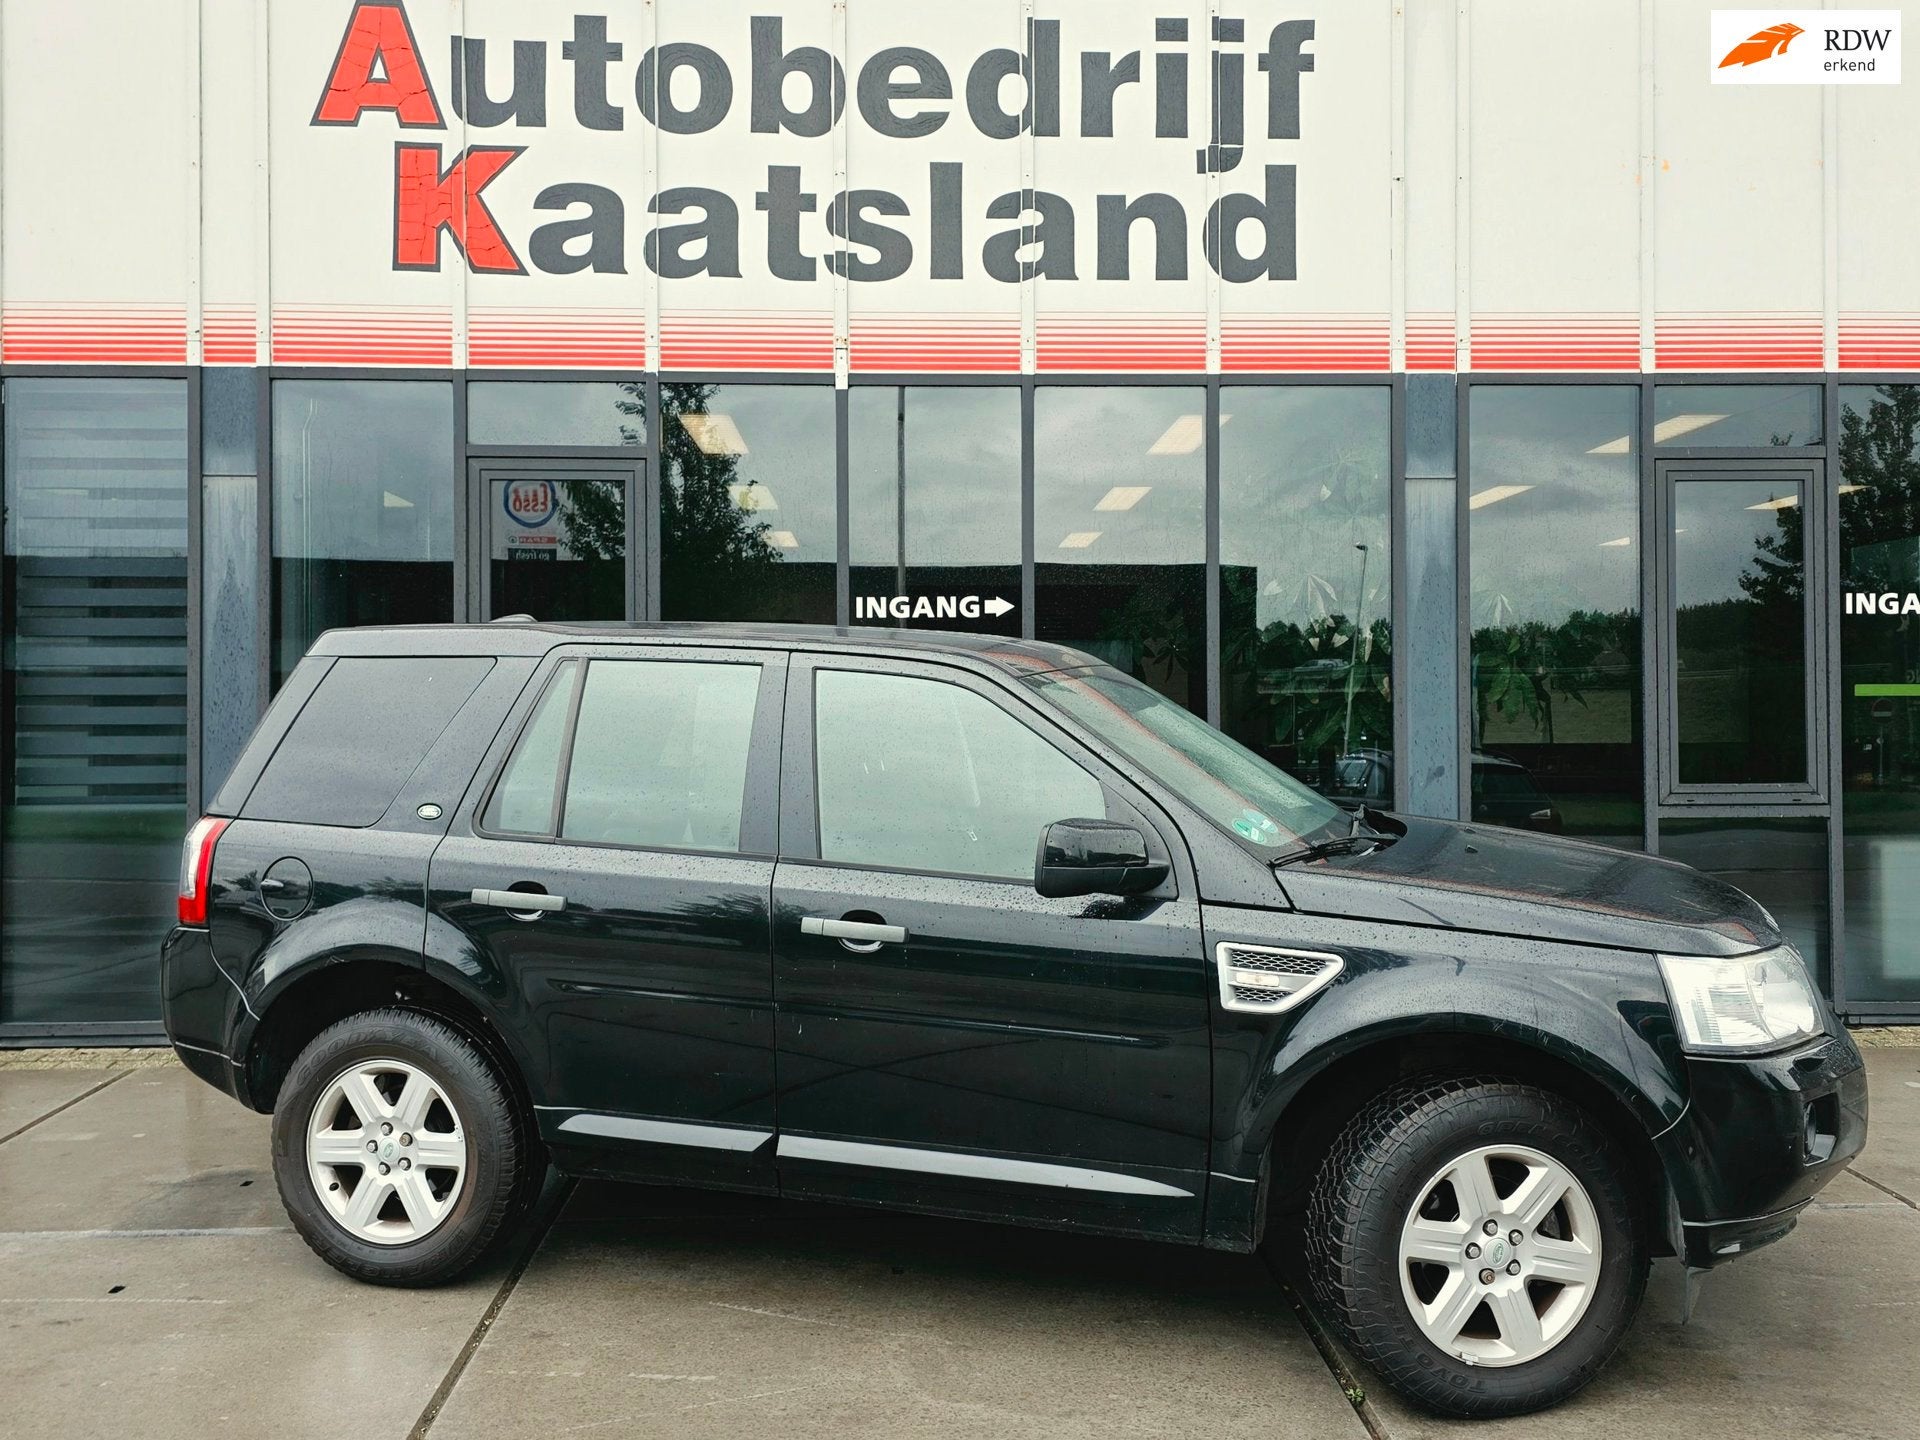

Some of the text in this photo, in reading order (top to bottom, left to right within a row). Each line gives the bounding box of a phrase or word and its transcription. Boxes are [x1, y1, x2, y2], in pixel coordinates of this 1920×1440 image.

[309, 0, 1315, 174] Autobedrijf
[392, 141, 1297, 283] Kaatsland
[855, 595, 981, 619] INGANG
